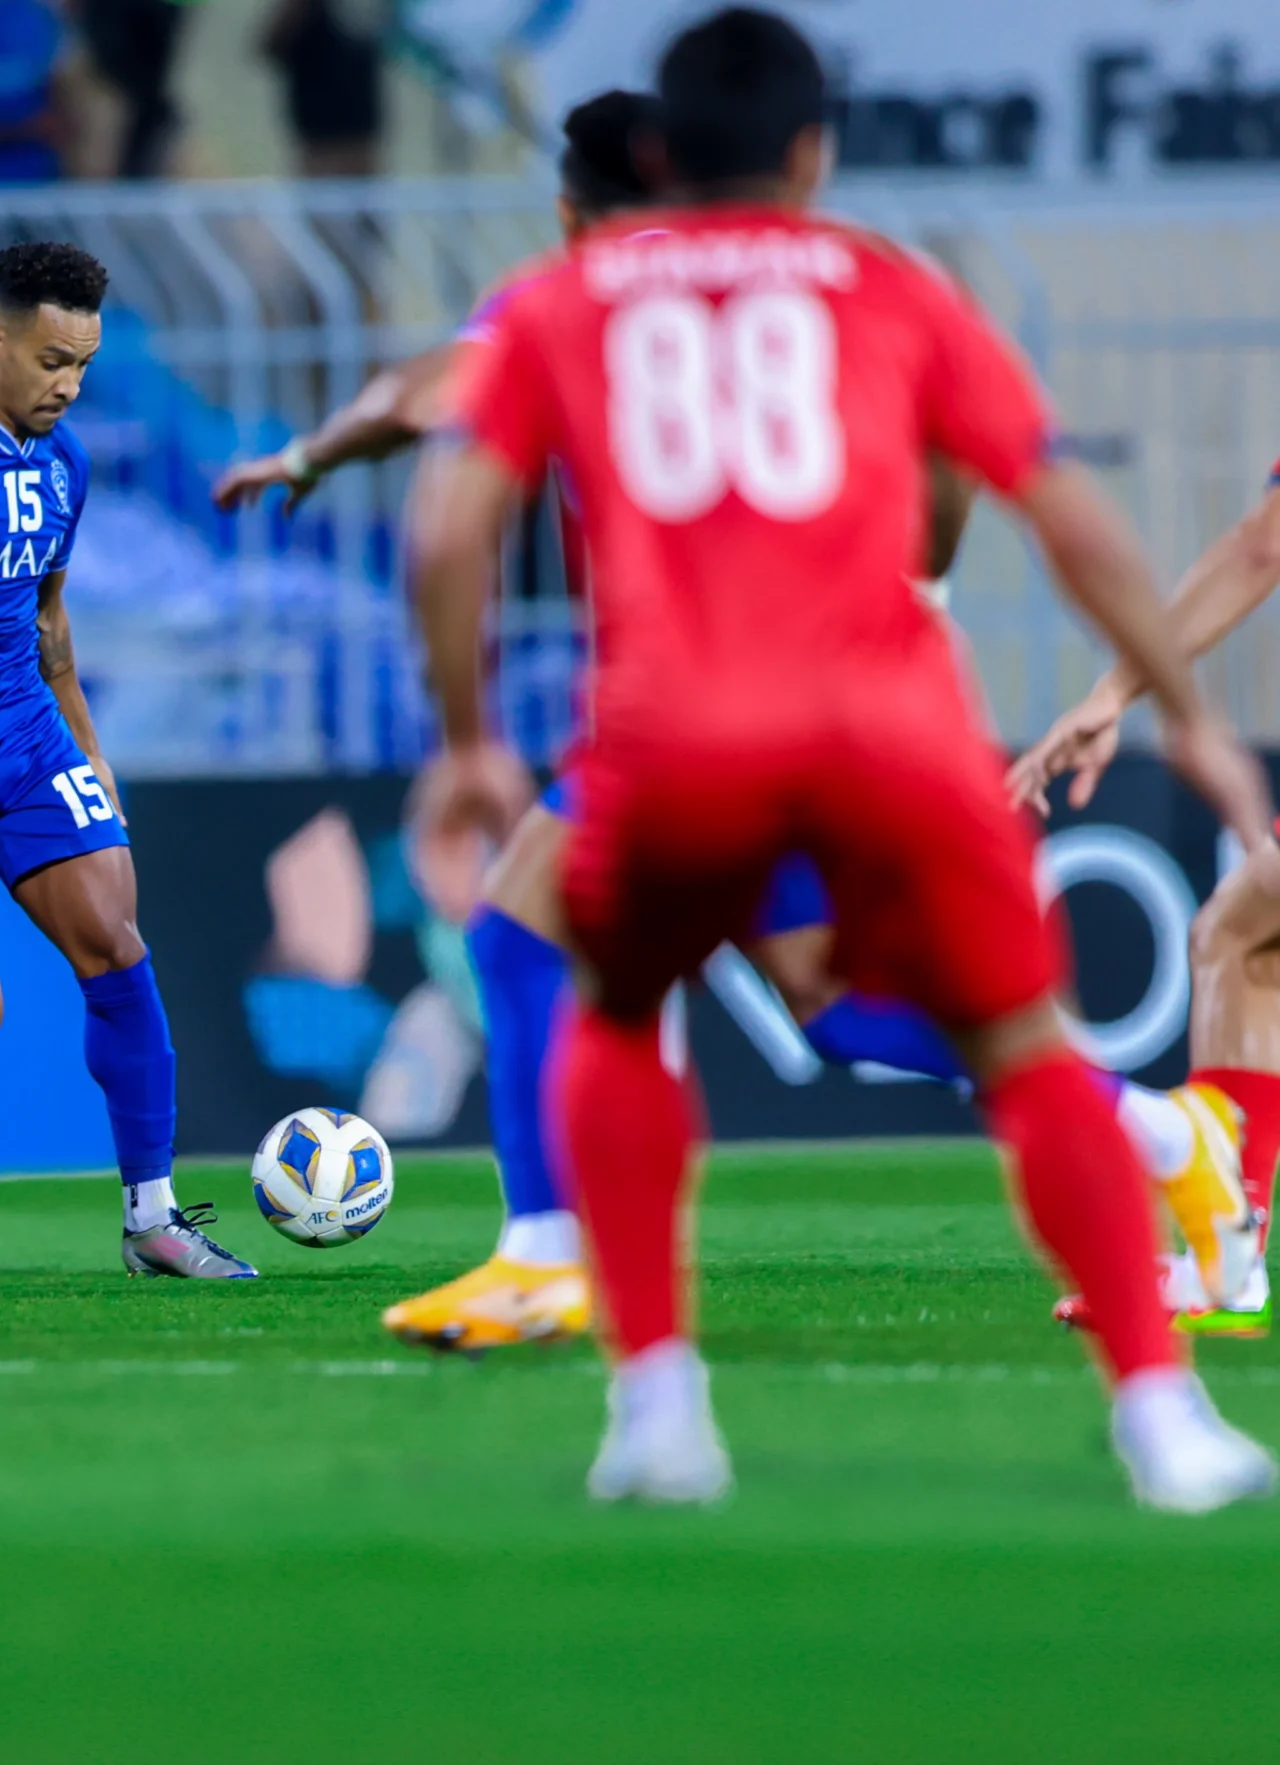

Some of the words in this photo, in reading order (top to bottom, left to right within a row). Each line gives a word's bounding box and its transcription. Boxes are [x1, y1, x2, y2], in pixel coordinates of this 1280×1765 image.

[602, 293, 846, 522] 88
[3, 470, 43, 534] 15
[51, 763, 115, 830] 15
[345, 1188, 388, 1219] molten
